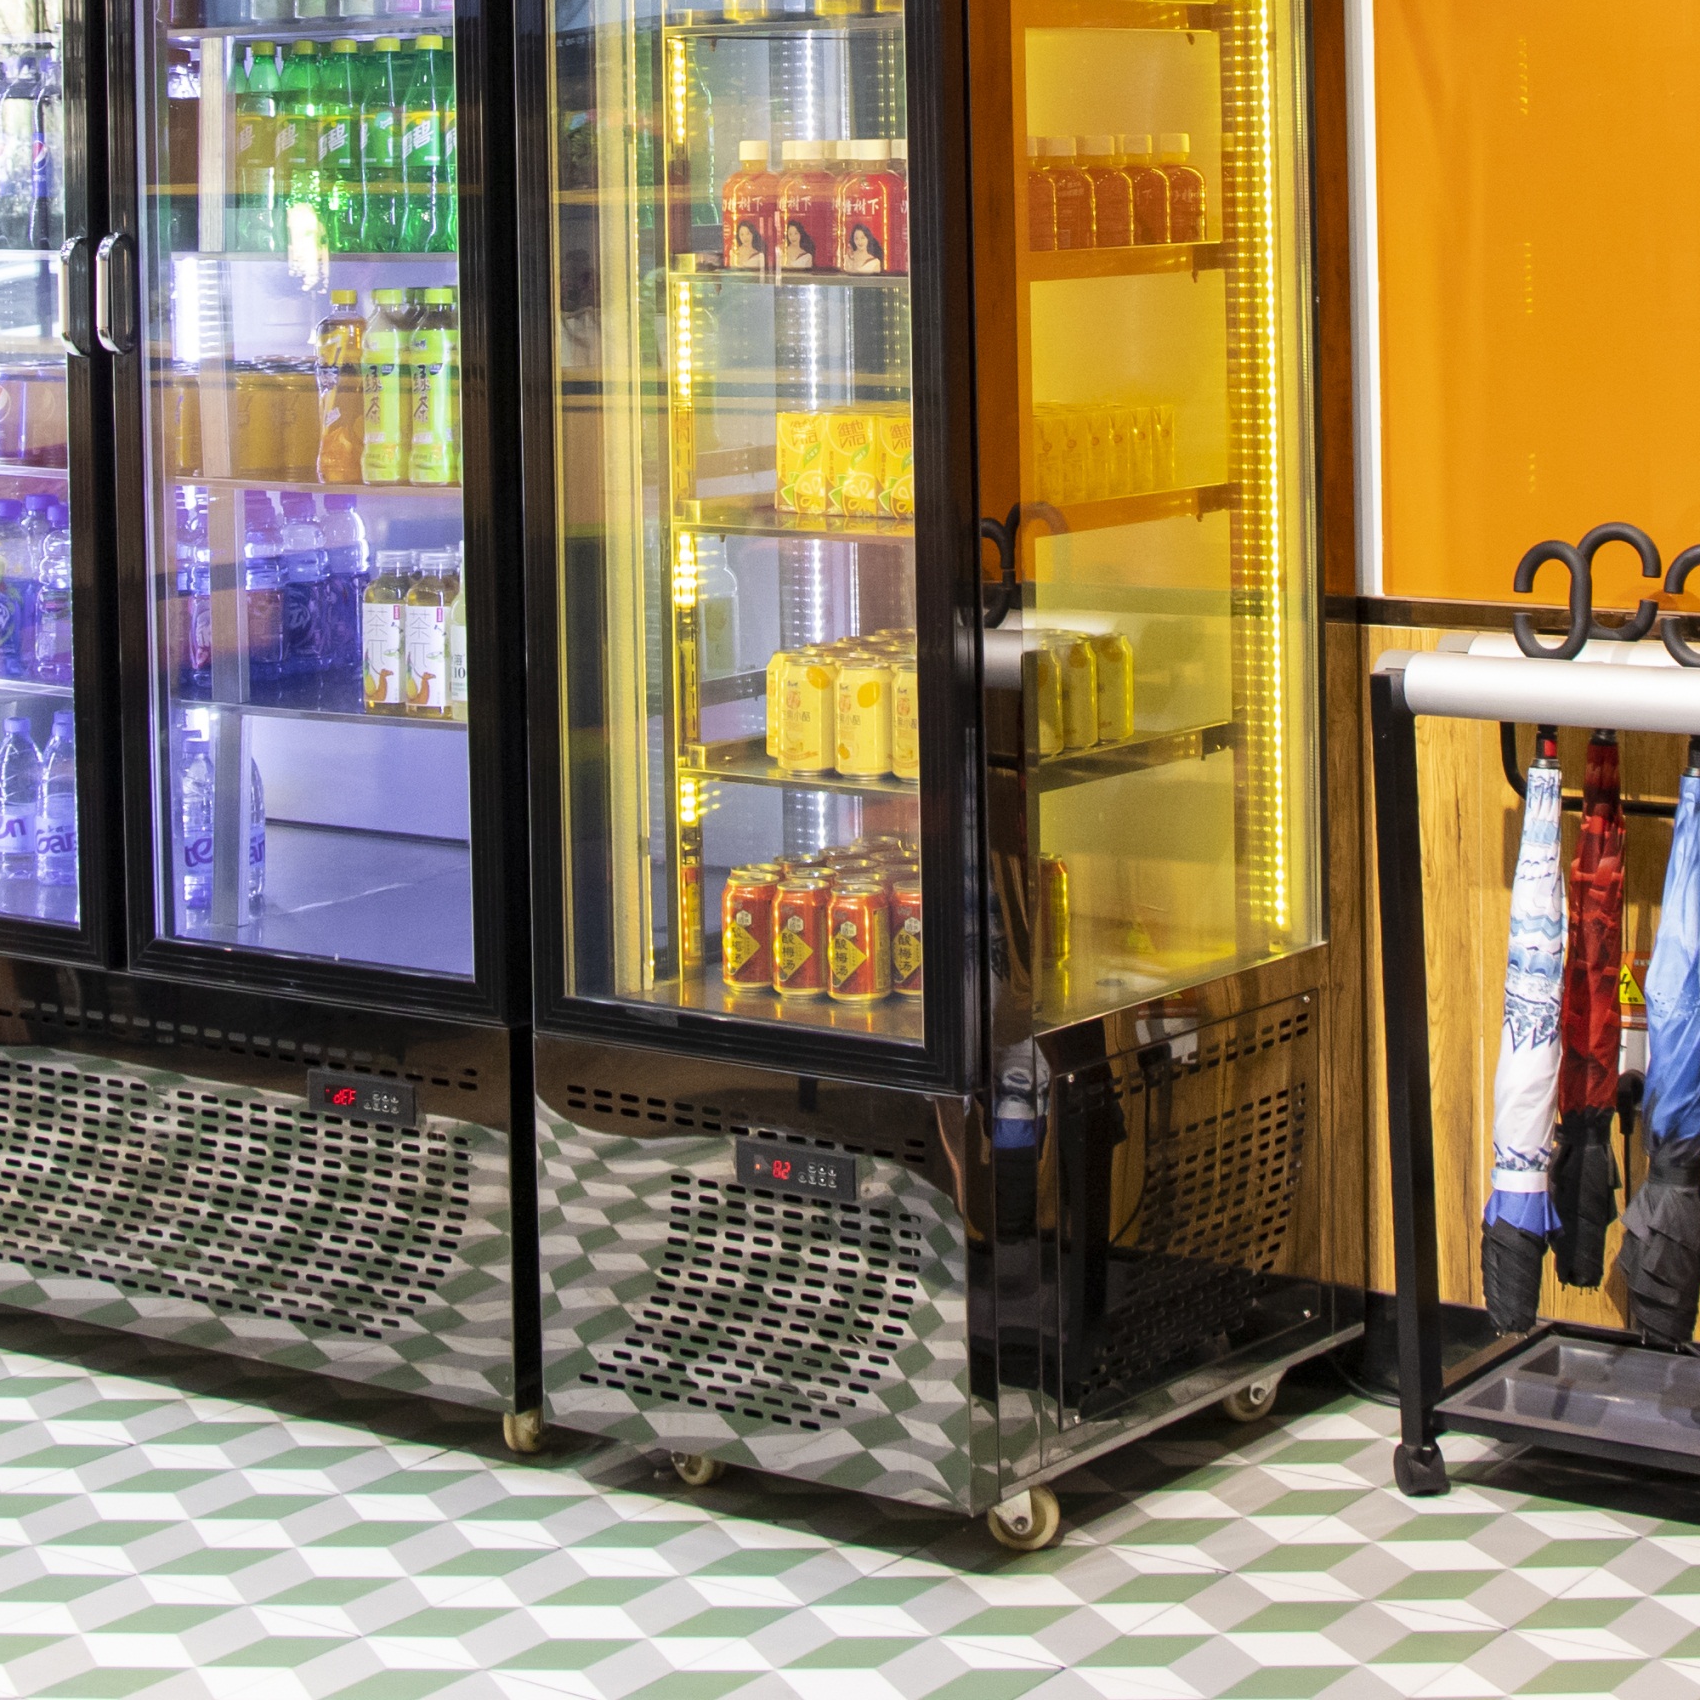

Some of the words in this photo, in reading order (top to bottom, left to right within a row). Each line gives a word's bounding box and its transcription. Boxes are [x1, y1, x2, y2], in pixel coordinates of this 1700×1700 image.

[781, 932, 796, 971] 酸梅汤
[834, 938, 848, 977] 酸梅汤
[897, 934, 913, 972] 酸梅汤
